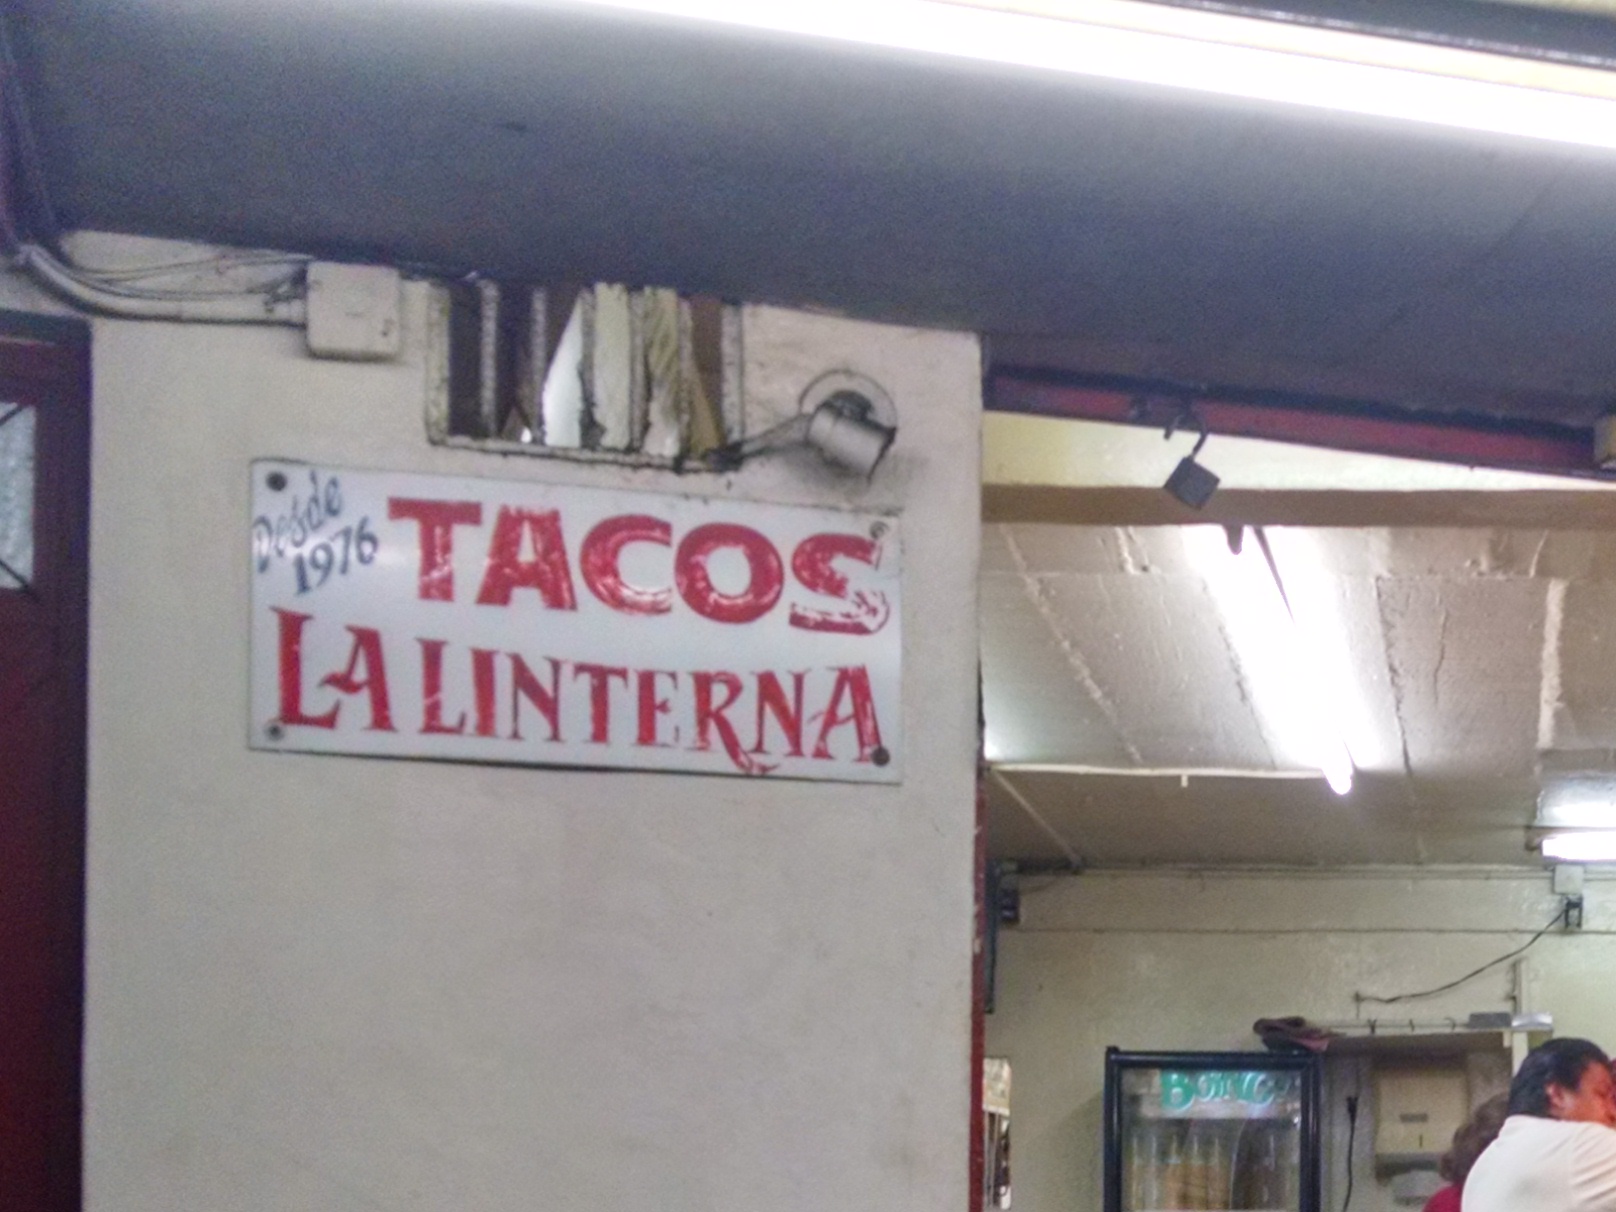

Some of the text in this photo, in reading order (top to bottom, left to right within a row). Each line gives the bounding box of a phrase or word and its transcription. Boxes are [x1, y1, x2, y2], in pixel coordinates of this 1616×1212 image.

[295, 516, 379, 595] 1976
[388, 497, 889, 634] TACOS
[269, 606, 888, 774] LA LINTERNA
